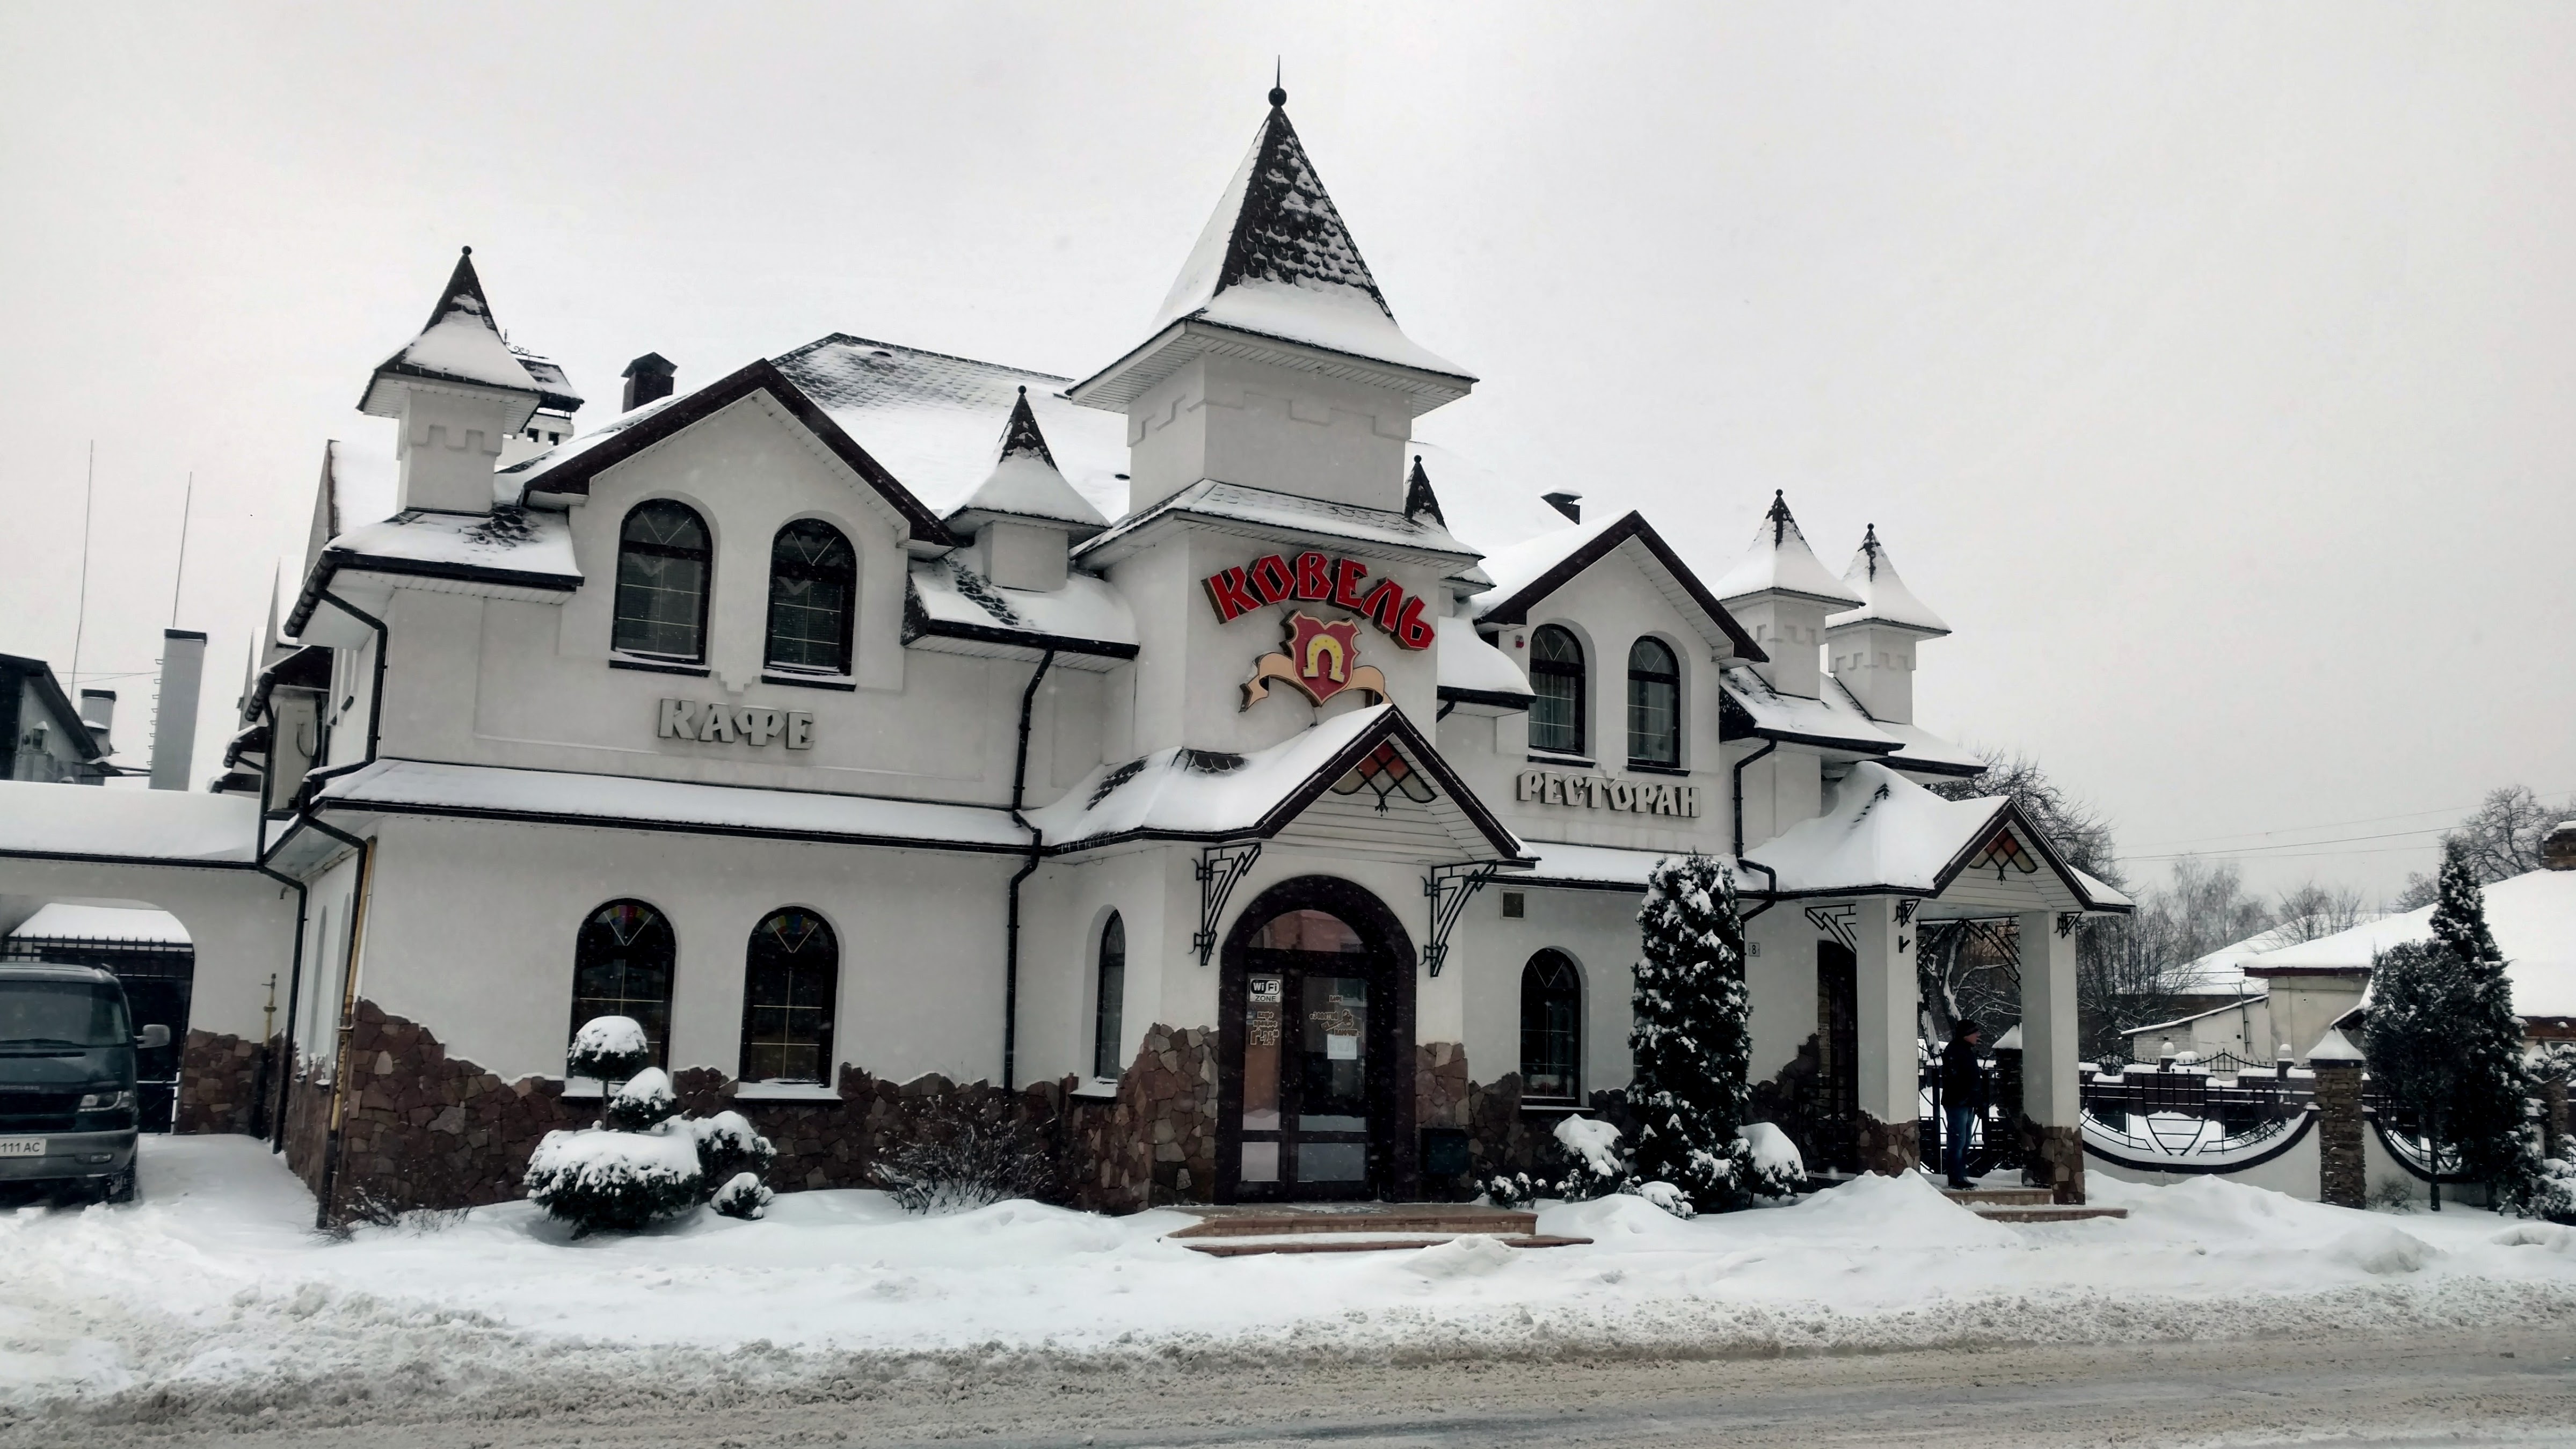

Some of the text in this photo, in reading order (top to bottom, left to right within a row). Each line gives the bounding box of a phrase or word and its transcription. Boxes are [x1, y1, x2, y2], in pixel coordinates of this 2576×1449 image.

[1202, 551, 1436, 651] КОВЕЛЬ
[658, 697, 816, 750] КАФЕ
[1517, 769, 1701, 818] РЕСТОРАН
[1752, 944, 1757, 955] 8
